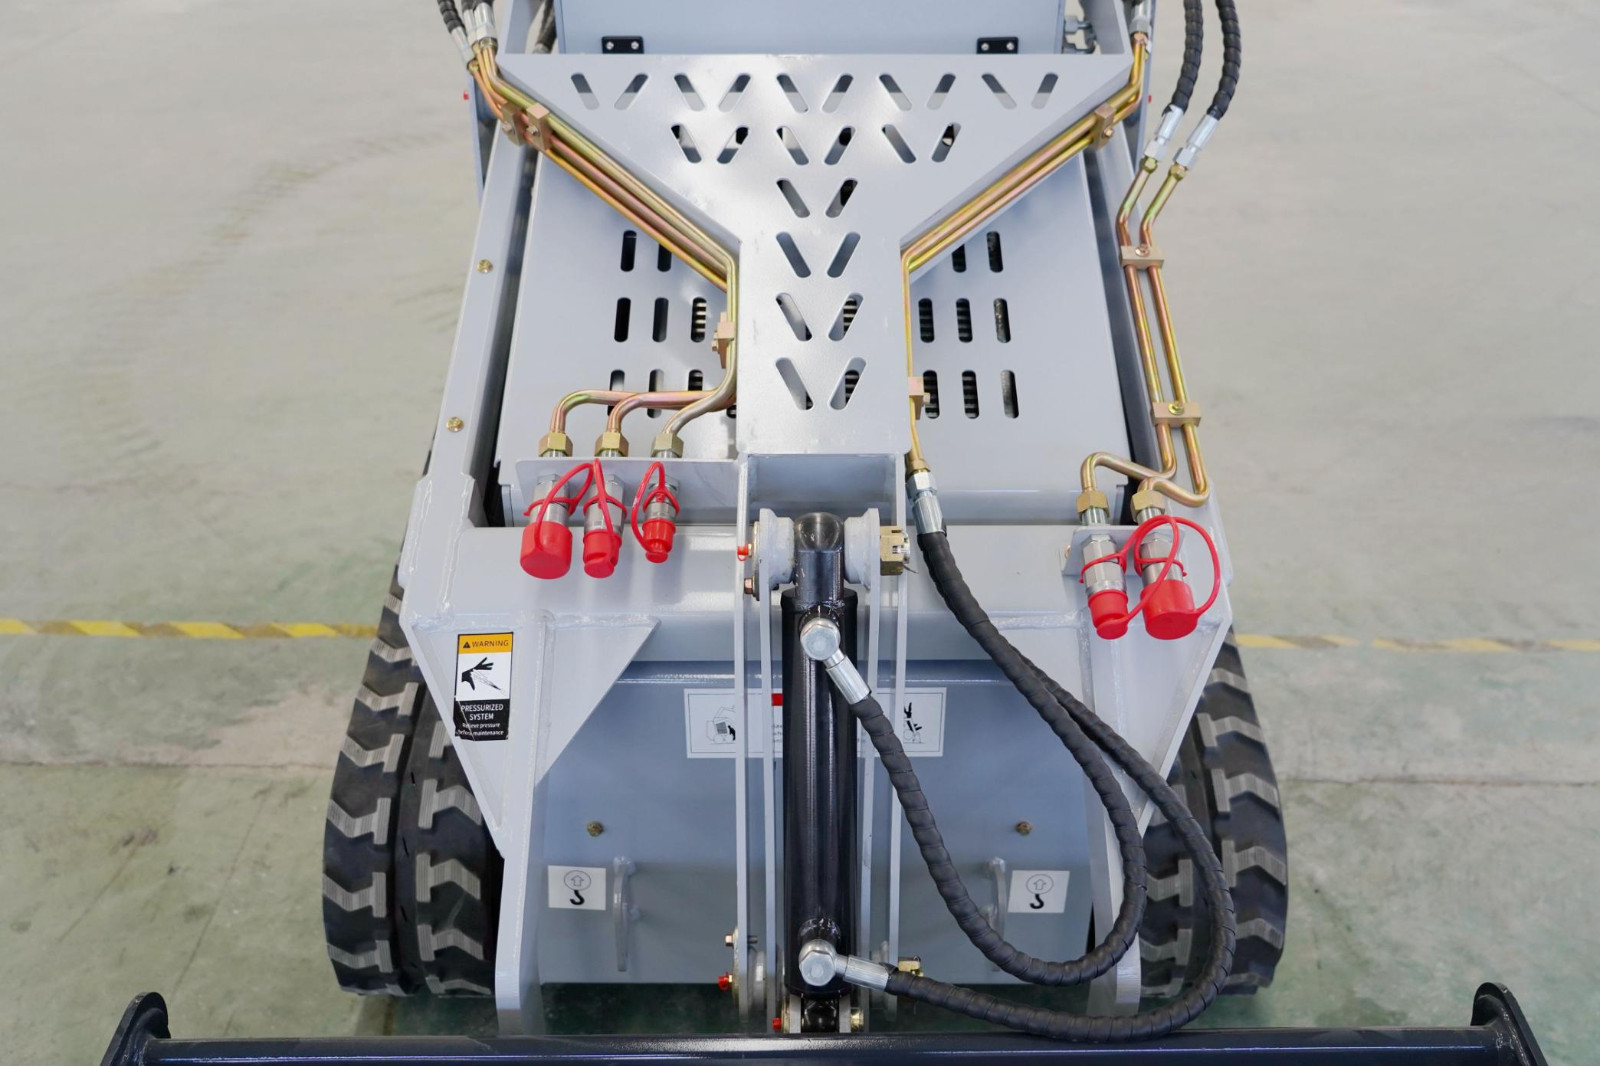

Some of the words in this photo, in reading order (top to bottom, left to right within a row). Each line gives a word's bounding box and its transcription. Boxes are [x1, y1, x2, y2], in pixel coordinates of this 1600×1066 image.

[471, 640, 509, 648] WARNING
[461, 704, 504, 712] PRESSURIZED
[469, 713, 494, 721] SYSTEM
